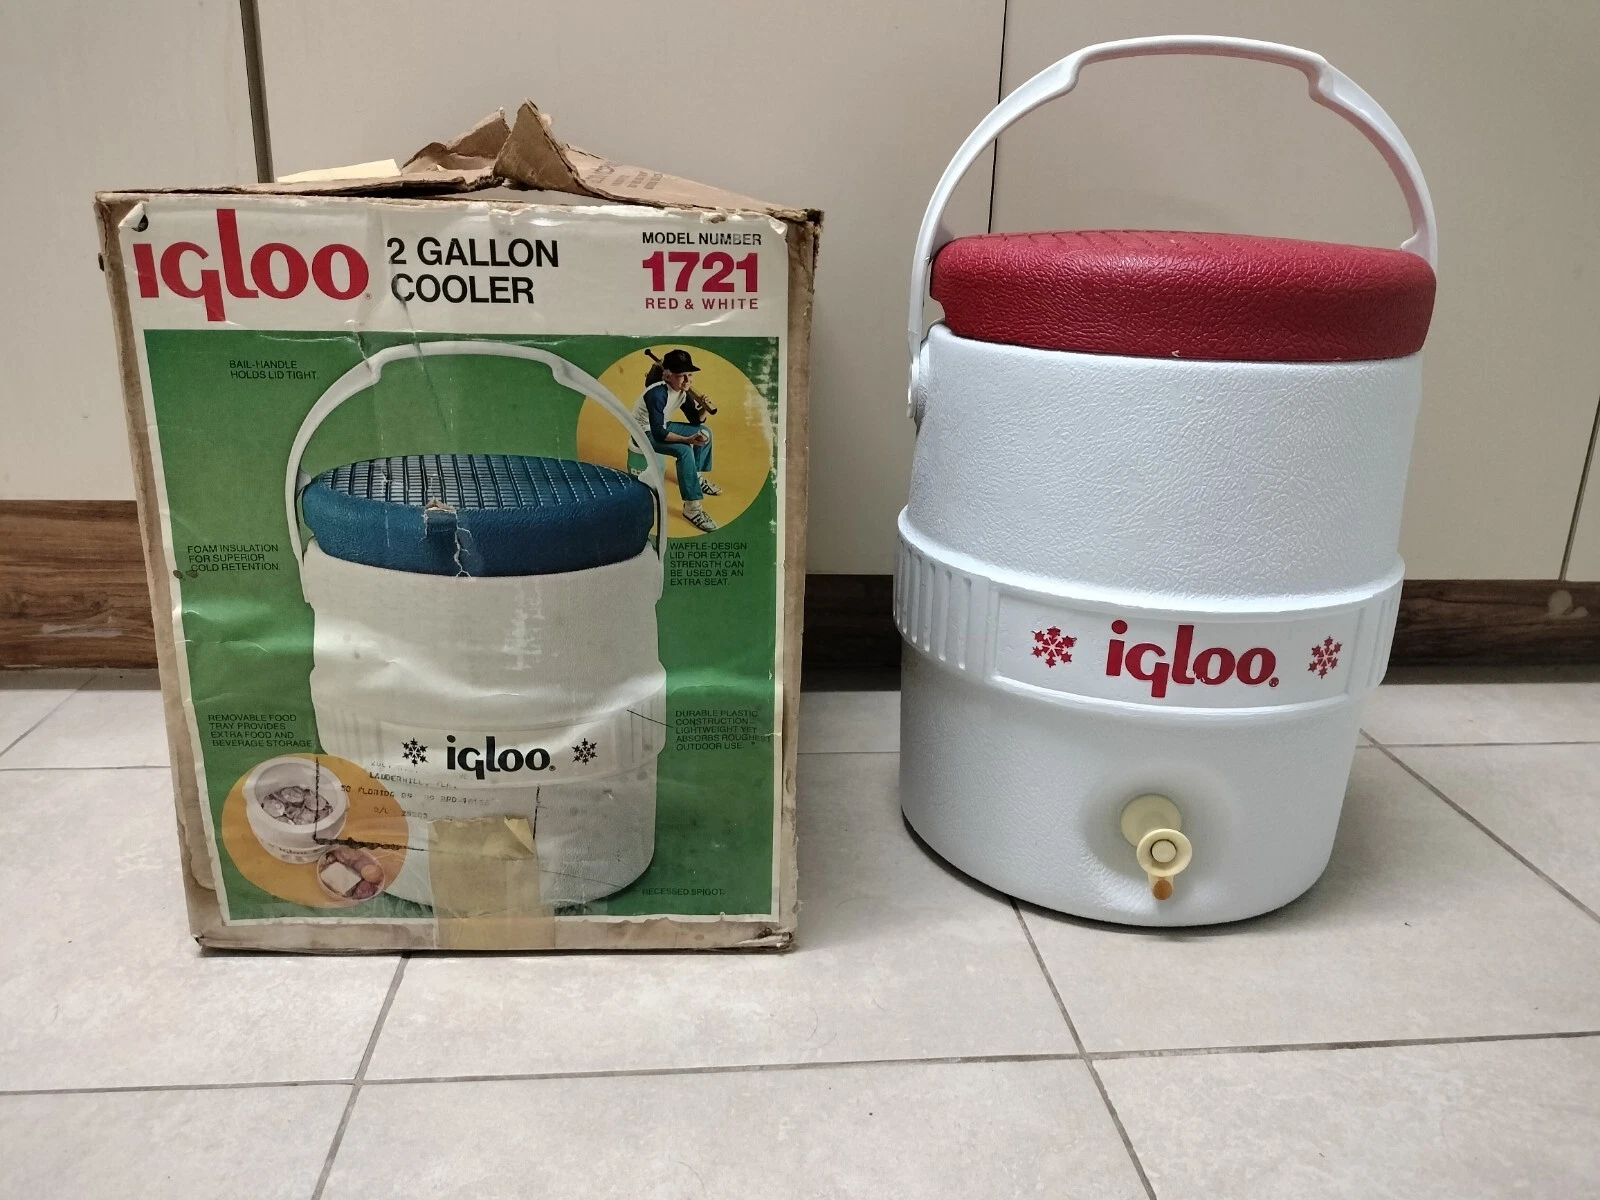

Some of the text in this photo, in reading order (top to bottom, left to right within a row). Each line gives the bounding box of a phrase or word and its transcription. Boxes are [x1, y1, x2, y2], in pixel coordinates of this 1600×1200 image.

[642, 232, 762, 245] MODEL NUMBER
[386, 236, 559, 268] 2 GALLON
[132, 208, 369, 322] igloo
[642, 250, 758, 292] 1721
[391, 273, 535, 304] COOLER
[645, 297, 759, 310] RED & WHITE
[229, 360, 298, 369] BAIL-HANDLE
[230, 370, 267, 379] HOLDS
[268, 370, 285, 379] LID
[187, 543, 279, 554] FOAM INSULATION
[669, 542, 748, 551] WAFFLE-DESIGN
[189, 553, 265, 563] FOR SUPERIOR
[669, 551, 741, 559] LID FOR EXTRA
[191, 562, 279, 572] COLD RETENTION
[670, 560, 744, 568] STRENGTH CAN
[670, 569, 744, 577] BE USED AS AN
[670, 578, 702, 586] EXTRA
[1105, 619, 1276, 698] igloo
[207, 713, 297, 722] REMOVABLE FOOD
[675, 709, 759, 718] DURABLE PLASTIC
[209, 722, 286, 730] TRAY PROVIDES
[675, 726, 758, 734] LIGHTWEIGHT YET
[210, 731, 295, 739] EXTRA FOOD AND
[676, 733, 772, 743] ABSORBS ROUGHEST
[212, 739, 265, 747] BEVERAGE
[676, 742, 722, 751] OUTDOOR
[446, 735, 551, 780] igloo
[642, 887, 690, 896] RECESSED
